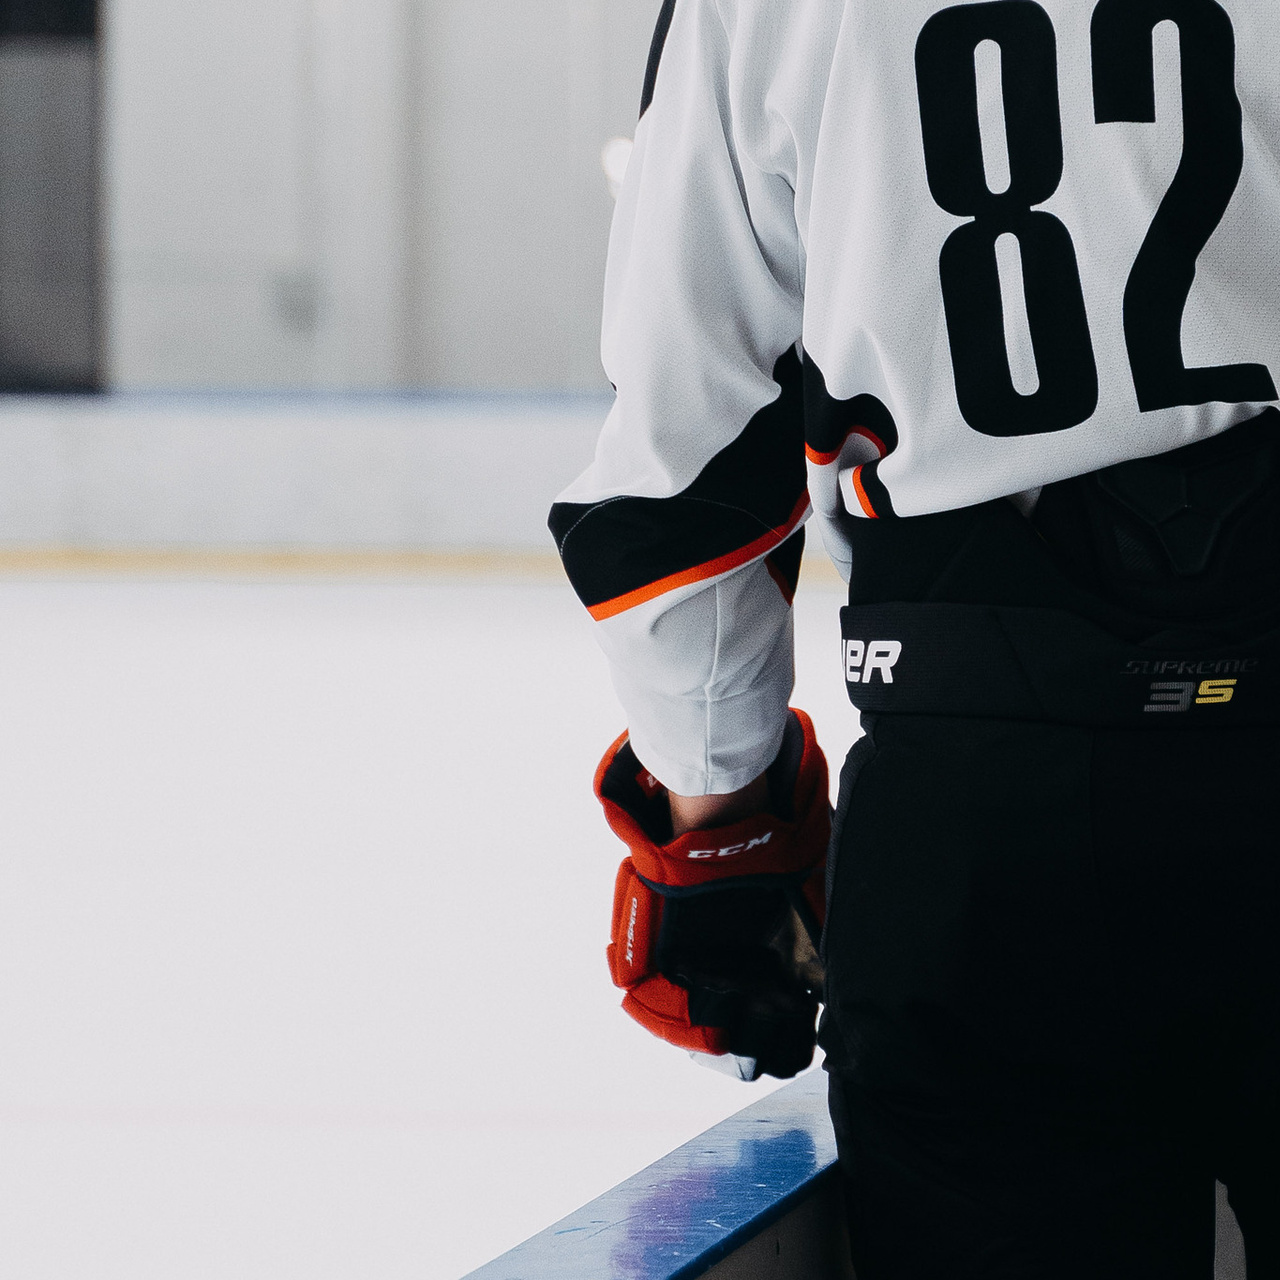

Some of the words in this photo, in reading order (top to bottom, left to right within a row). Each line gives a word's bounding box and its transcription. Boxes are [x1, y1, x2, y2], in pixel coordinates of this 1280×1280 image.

[842, 639, 903, 684] ER
[1120, 658, 1260, 675] SUPREME
[687, 831, 773, 859] CCM
